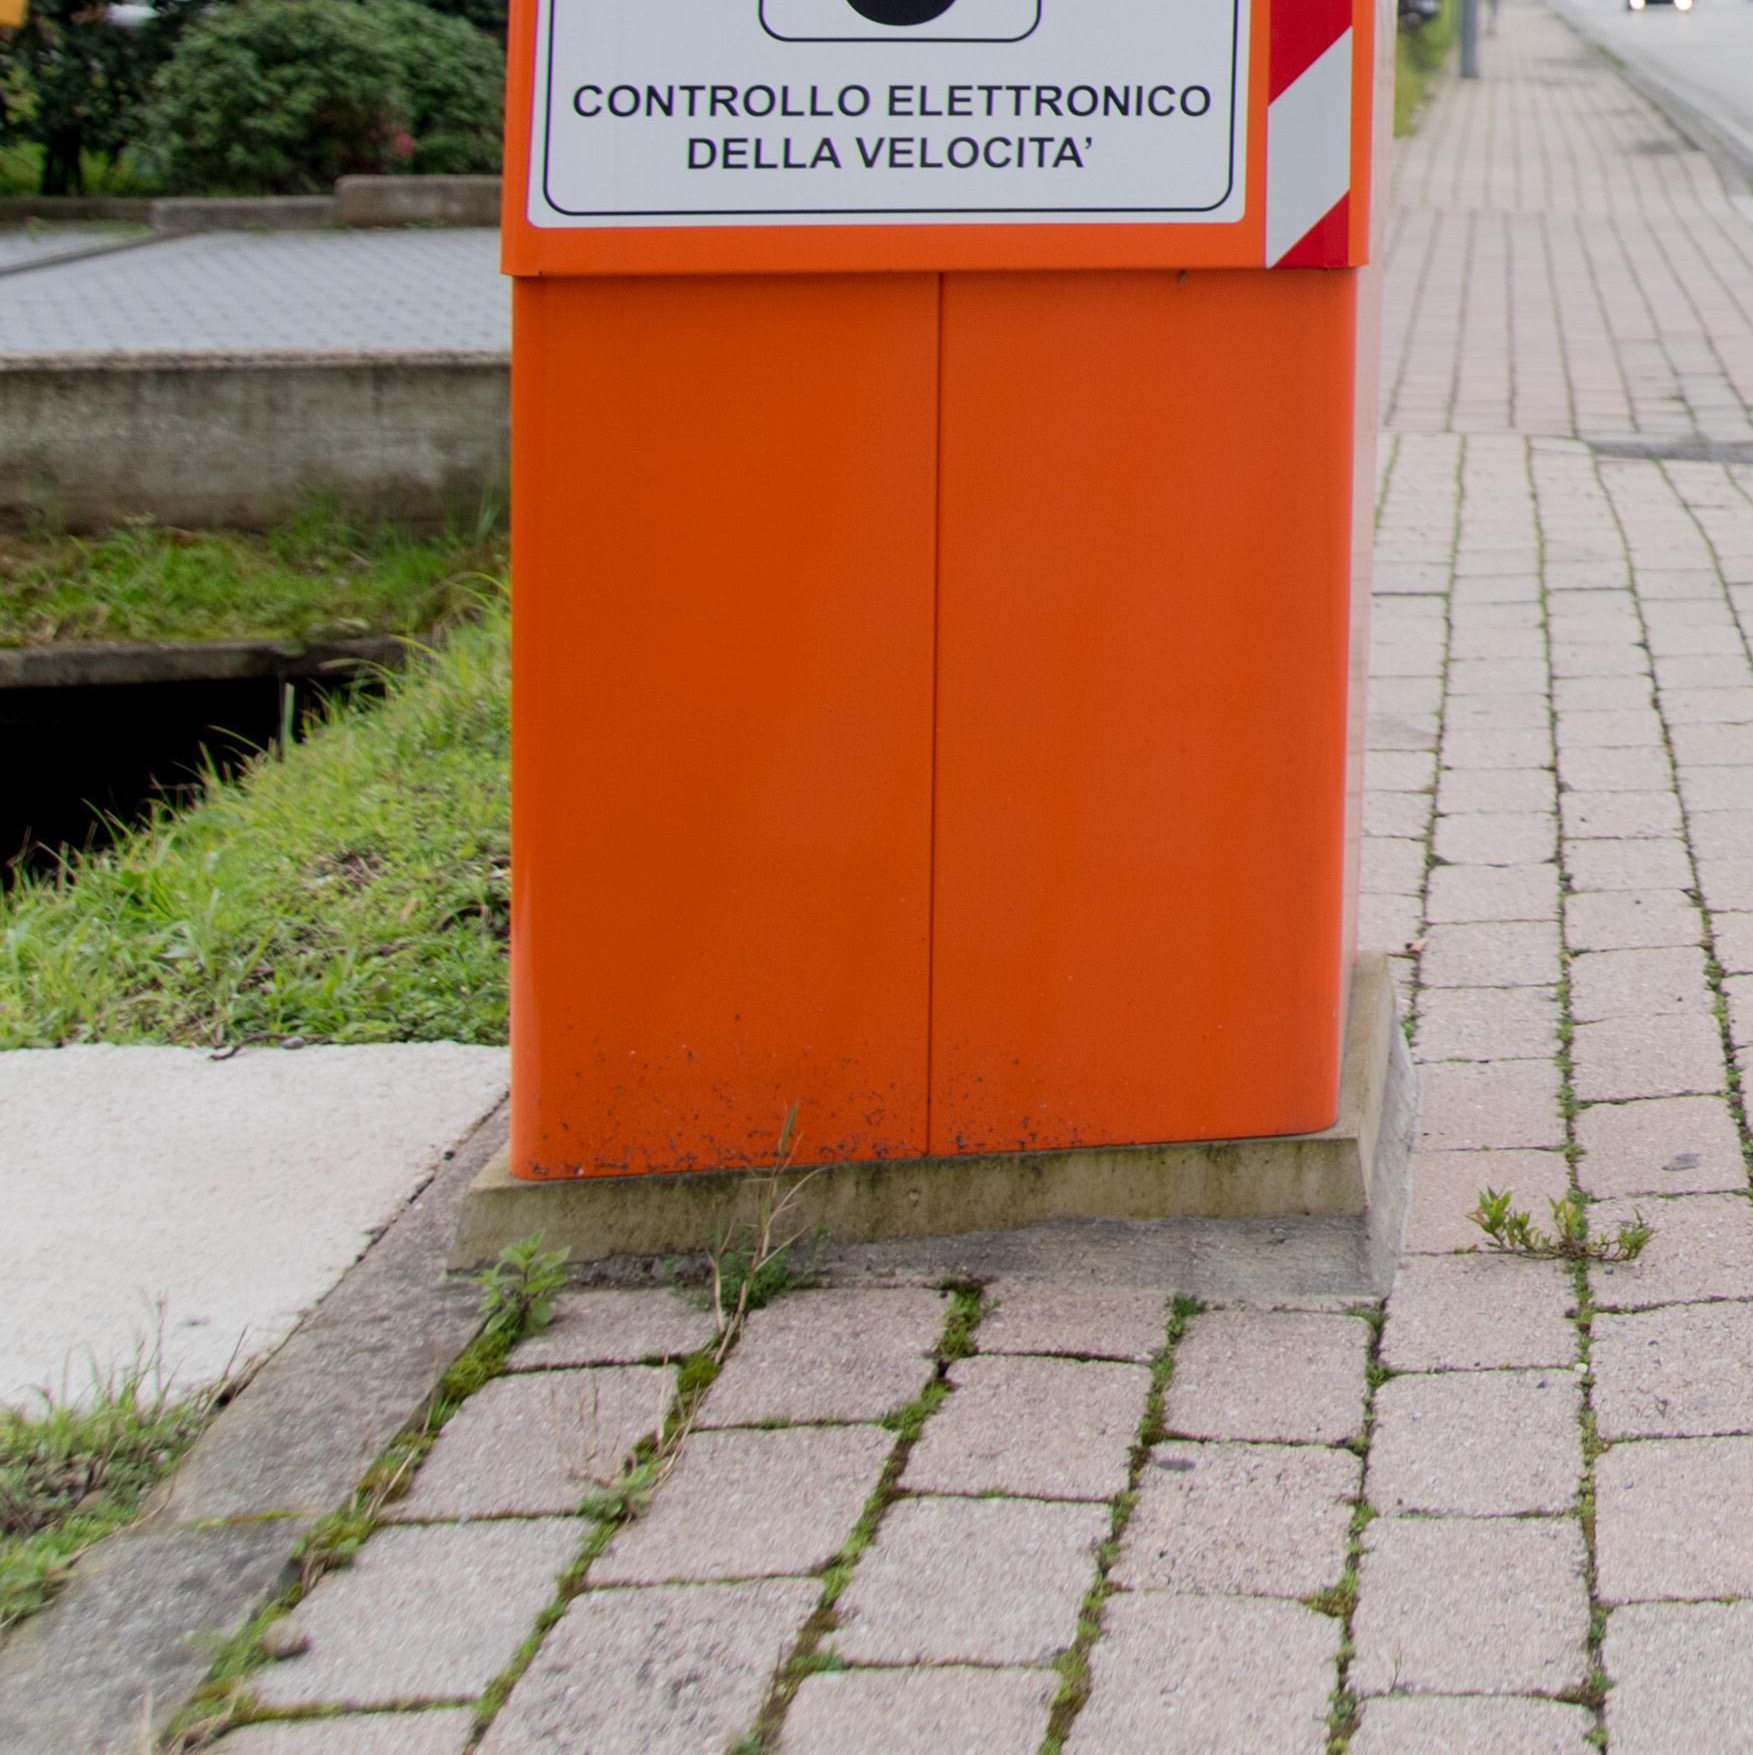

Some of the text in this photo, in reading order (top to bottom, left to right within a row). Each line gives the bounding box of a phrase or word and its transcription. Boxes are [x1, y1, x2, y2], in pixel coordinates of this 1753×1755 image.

[573, 84, 1212, 117] CONTROLLO ELETTRONICO
[687, 136, 1093, 169] DELLA VELOCITA'
